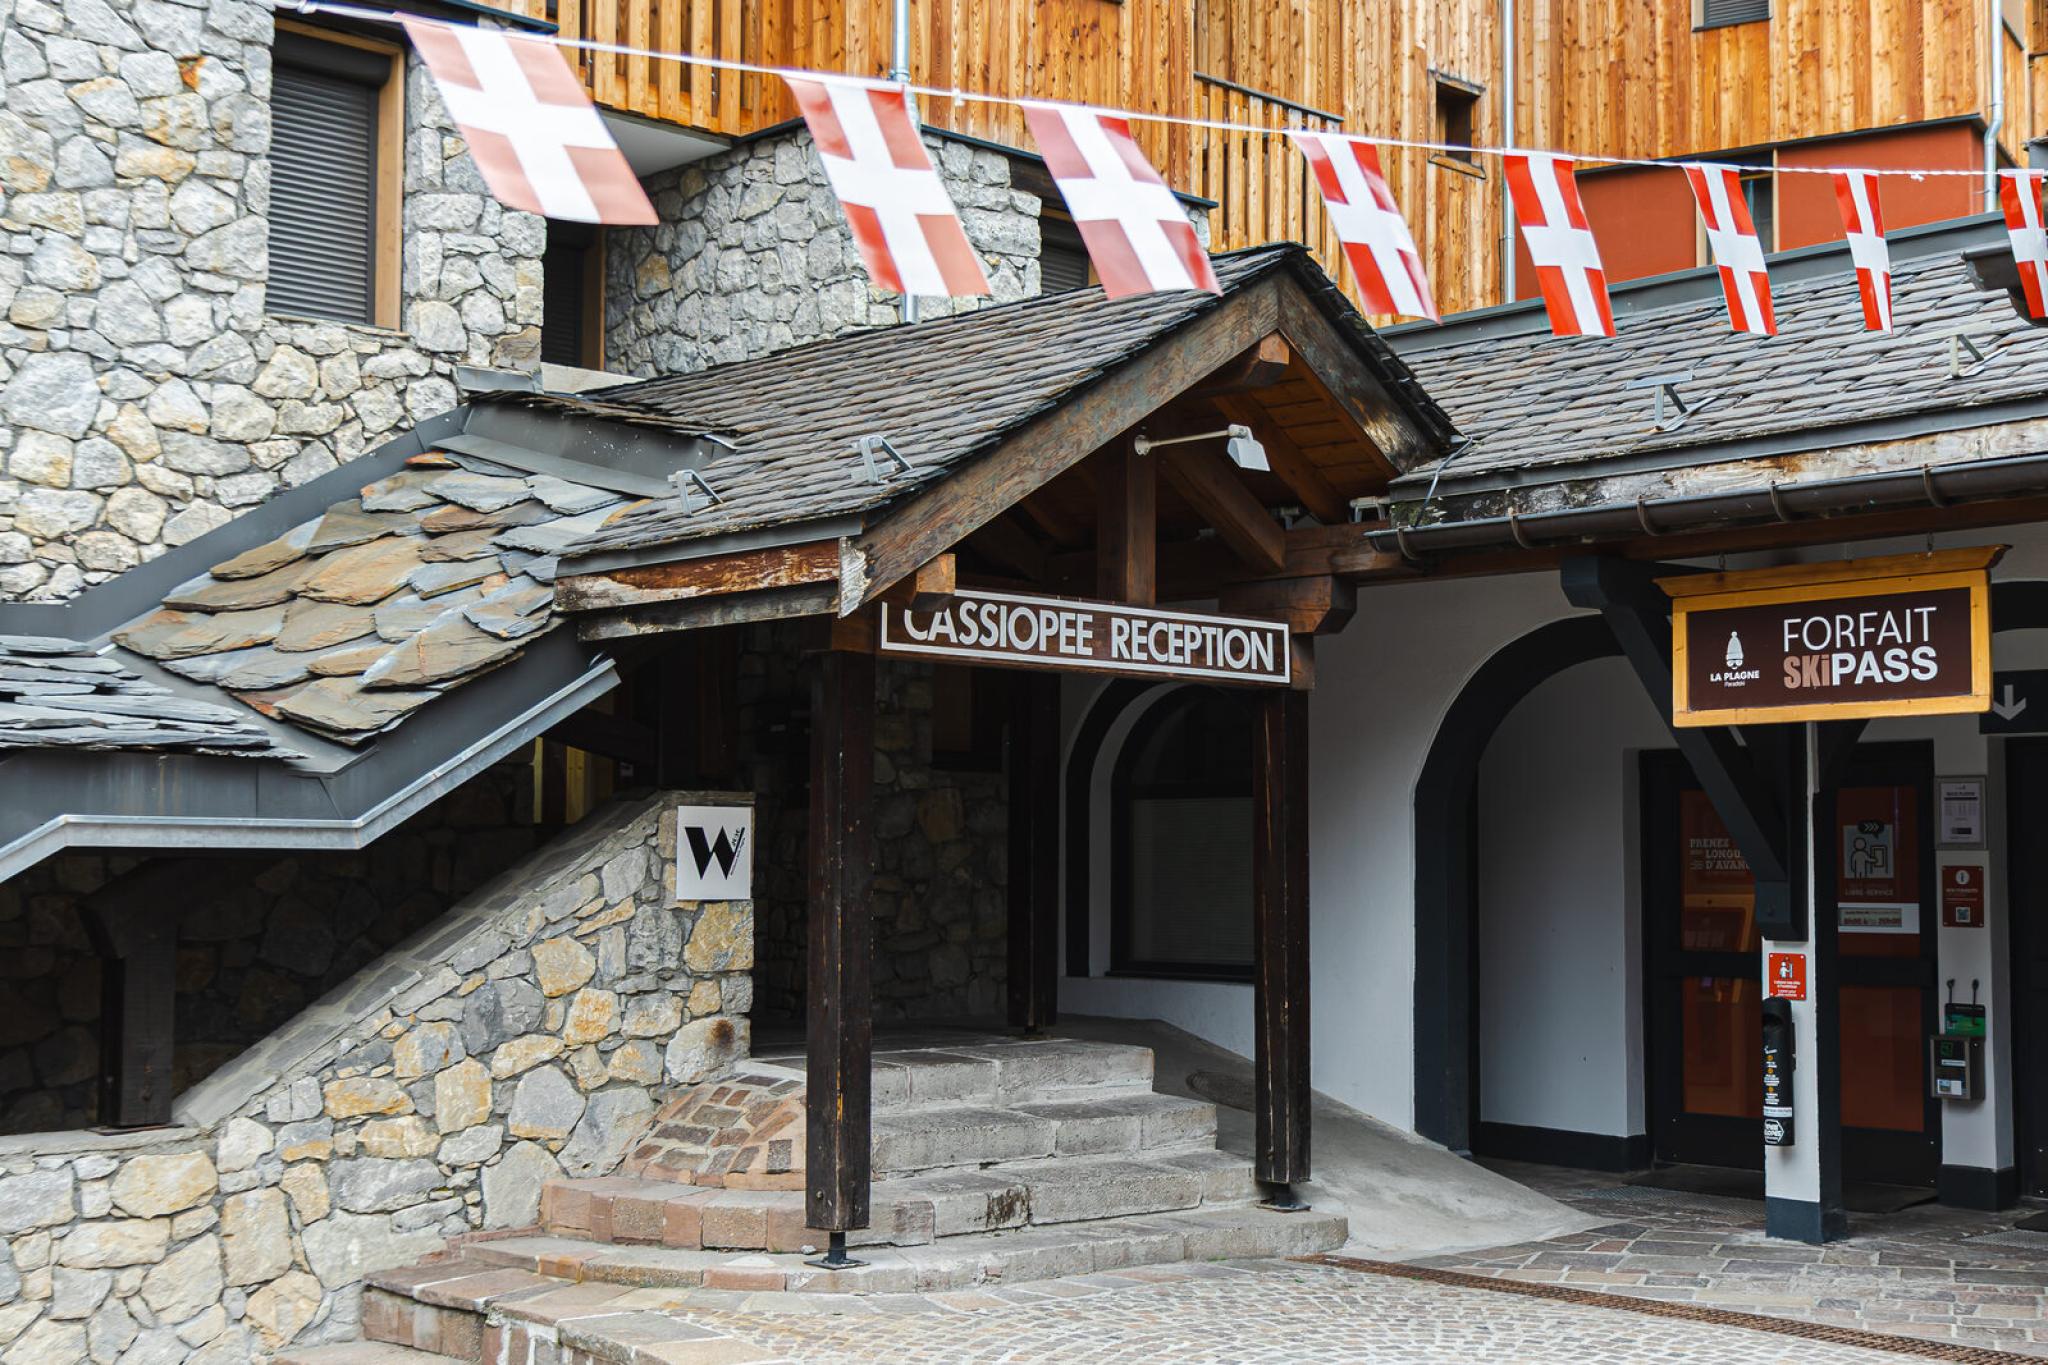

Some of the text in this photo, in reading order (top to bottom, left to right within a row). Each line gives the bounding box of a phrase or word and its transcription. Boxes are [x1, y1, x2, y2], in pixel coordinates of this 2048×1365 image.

[904, 601, 1274, 671] CASSIOPEE RECEPTION
[1784, 607, 1937, 652] FORFAIT
[1710, 669, 1760, 682] LA PLAGNE
[1705, 848, 1742, 858] LONGU
